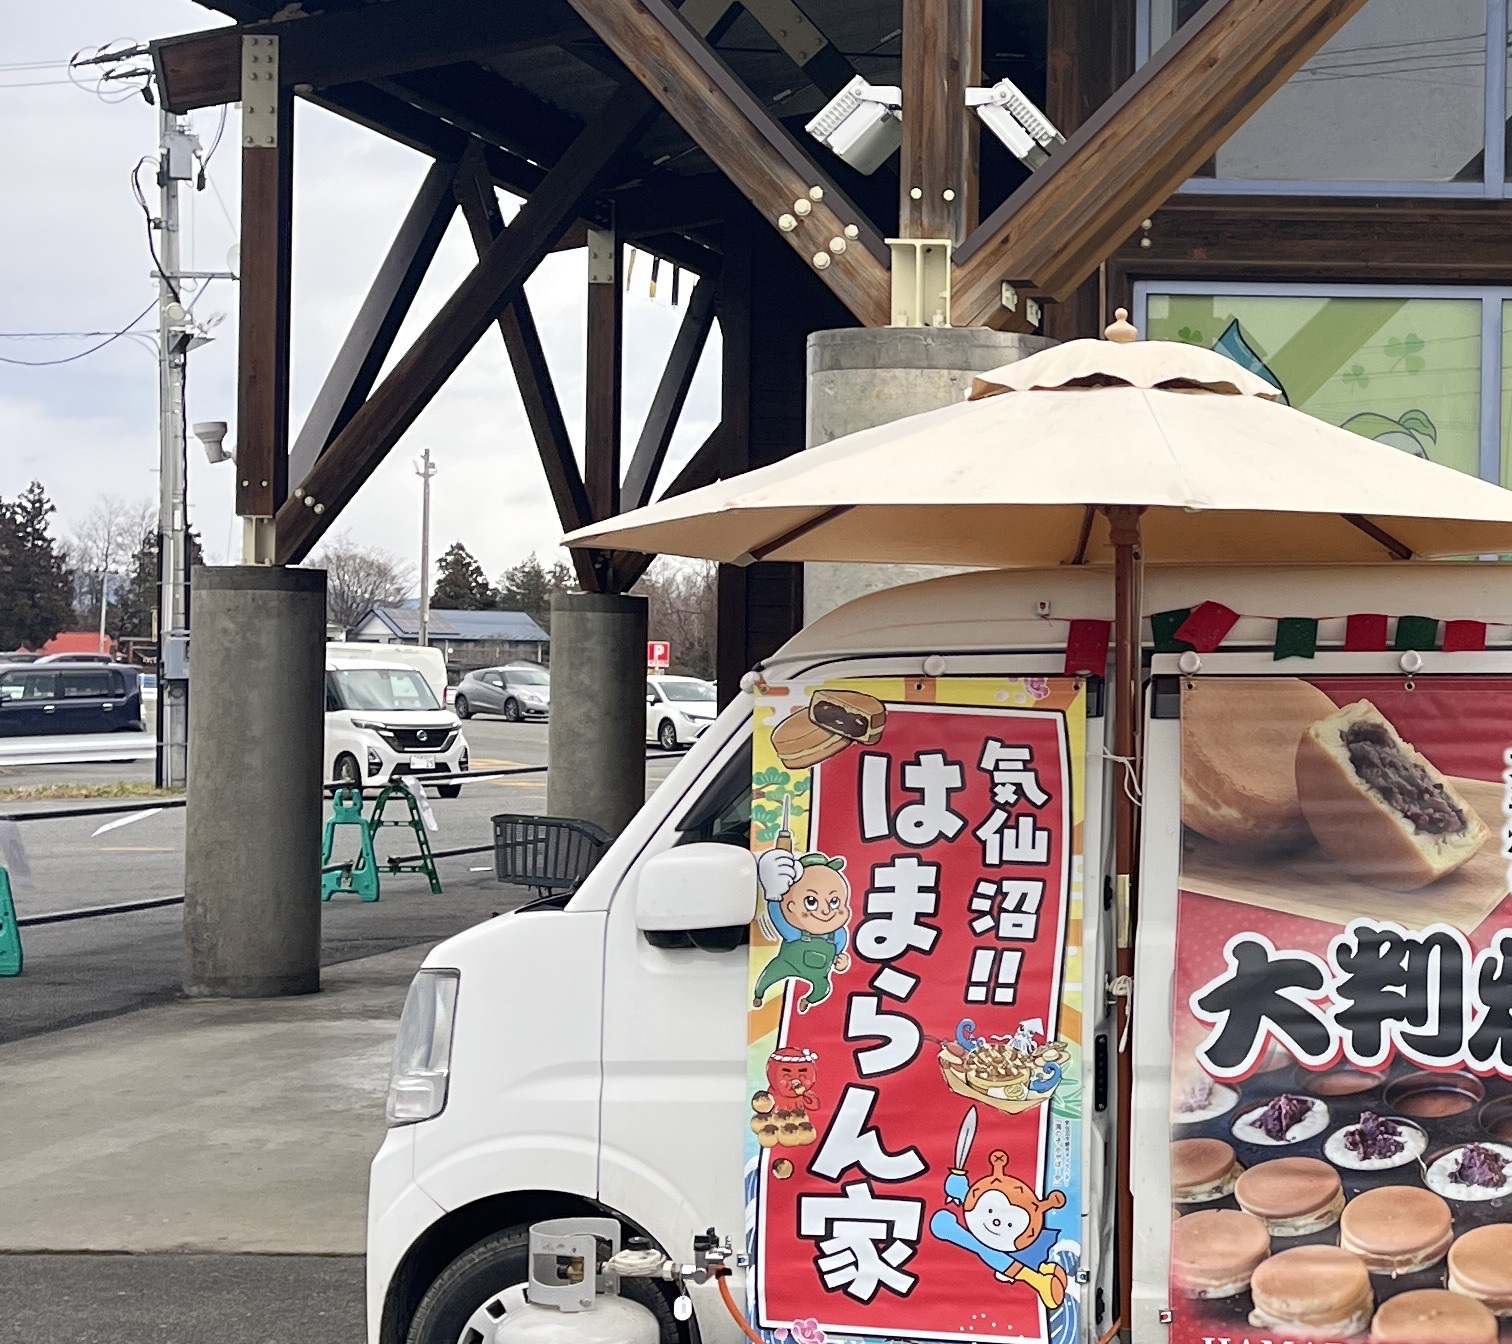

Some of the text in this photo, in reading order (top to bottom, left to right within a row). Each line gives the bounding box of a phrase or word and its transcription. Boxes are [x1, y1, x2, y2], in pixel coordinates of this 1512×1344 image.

[654, 645, 665, 660] P
[968, 739, 1049, 1006] 気仙沼!!
[800, 750, 966, 1304] はまらん家
